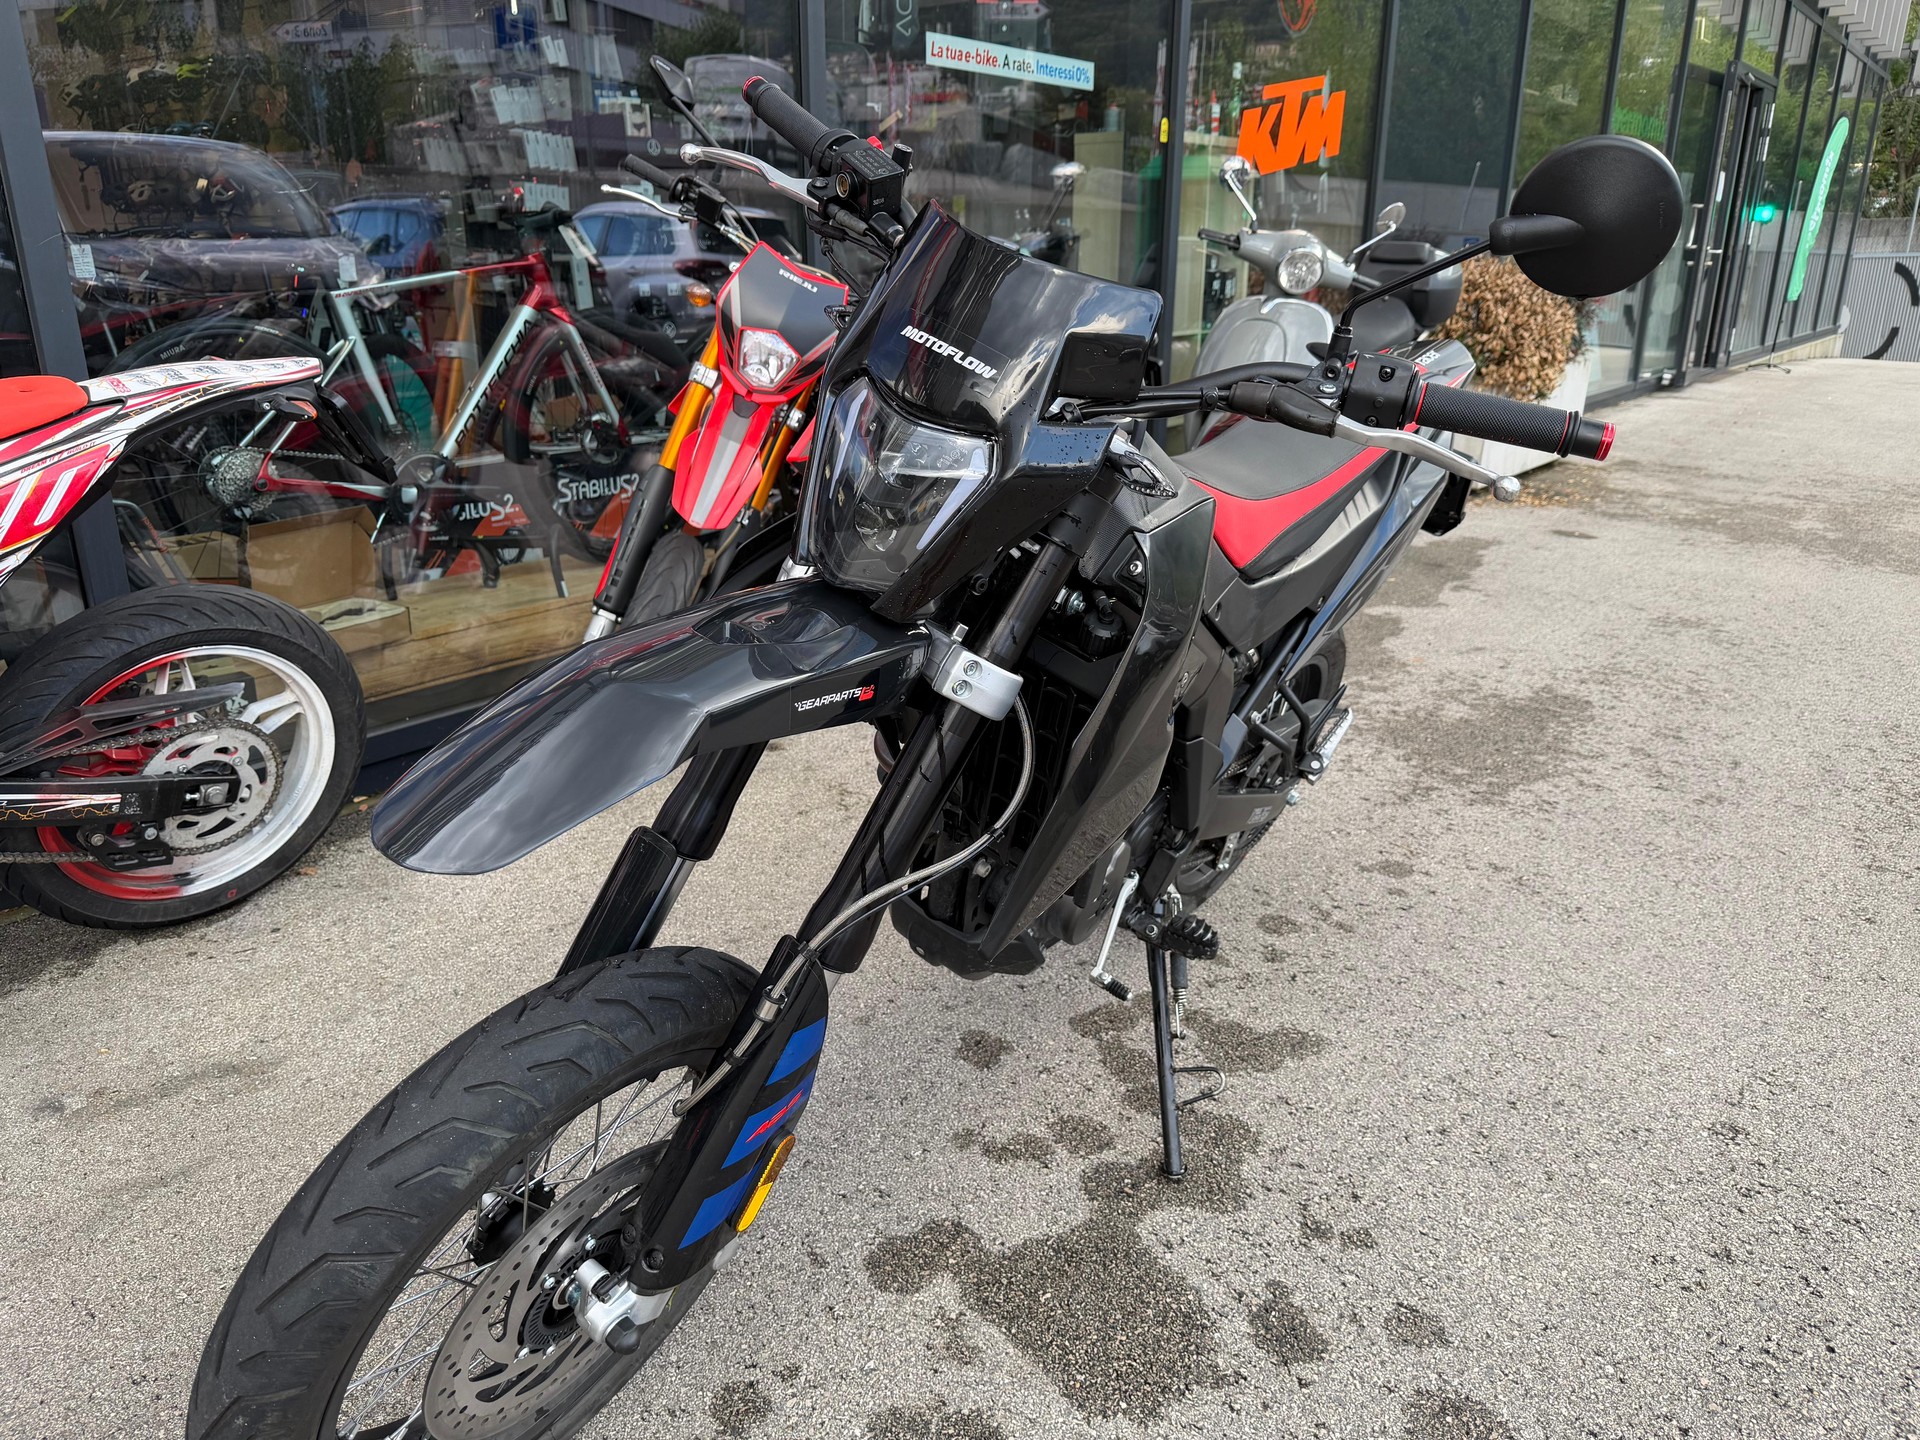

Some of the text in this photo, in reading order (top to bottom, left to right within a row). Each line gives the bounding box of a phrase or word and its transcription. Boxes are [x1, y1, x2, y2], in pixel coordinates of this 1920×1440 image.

[930, 40, 1091, 84] La tua e-bike. A rate. Interessi 0%
[1236, 75, 1346, 176] KTM
[778, 268, 819, 293] RIEJU
[160, 344, 187, 361] MIURA
[900, 325, 998, 379] MOTOFLOW
[454, 318, 534, 449] BOTTECCHIA
[798, 686, 863, 712] GEARPARTS
